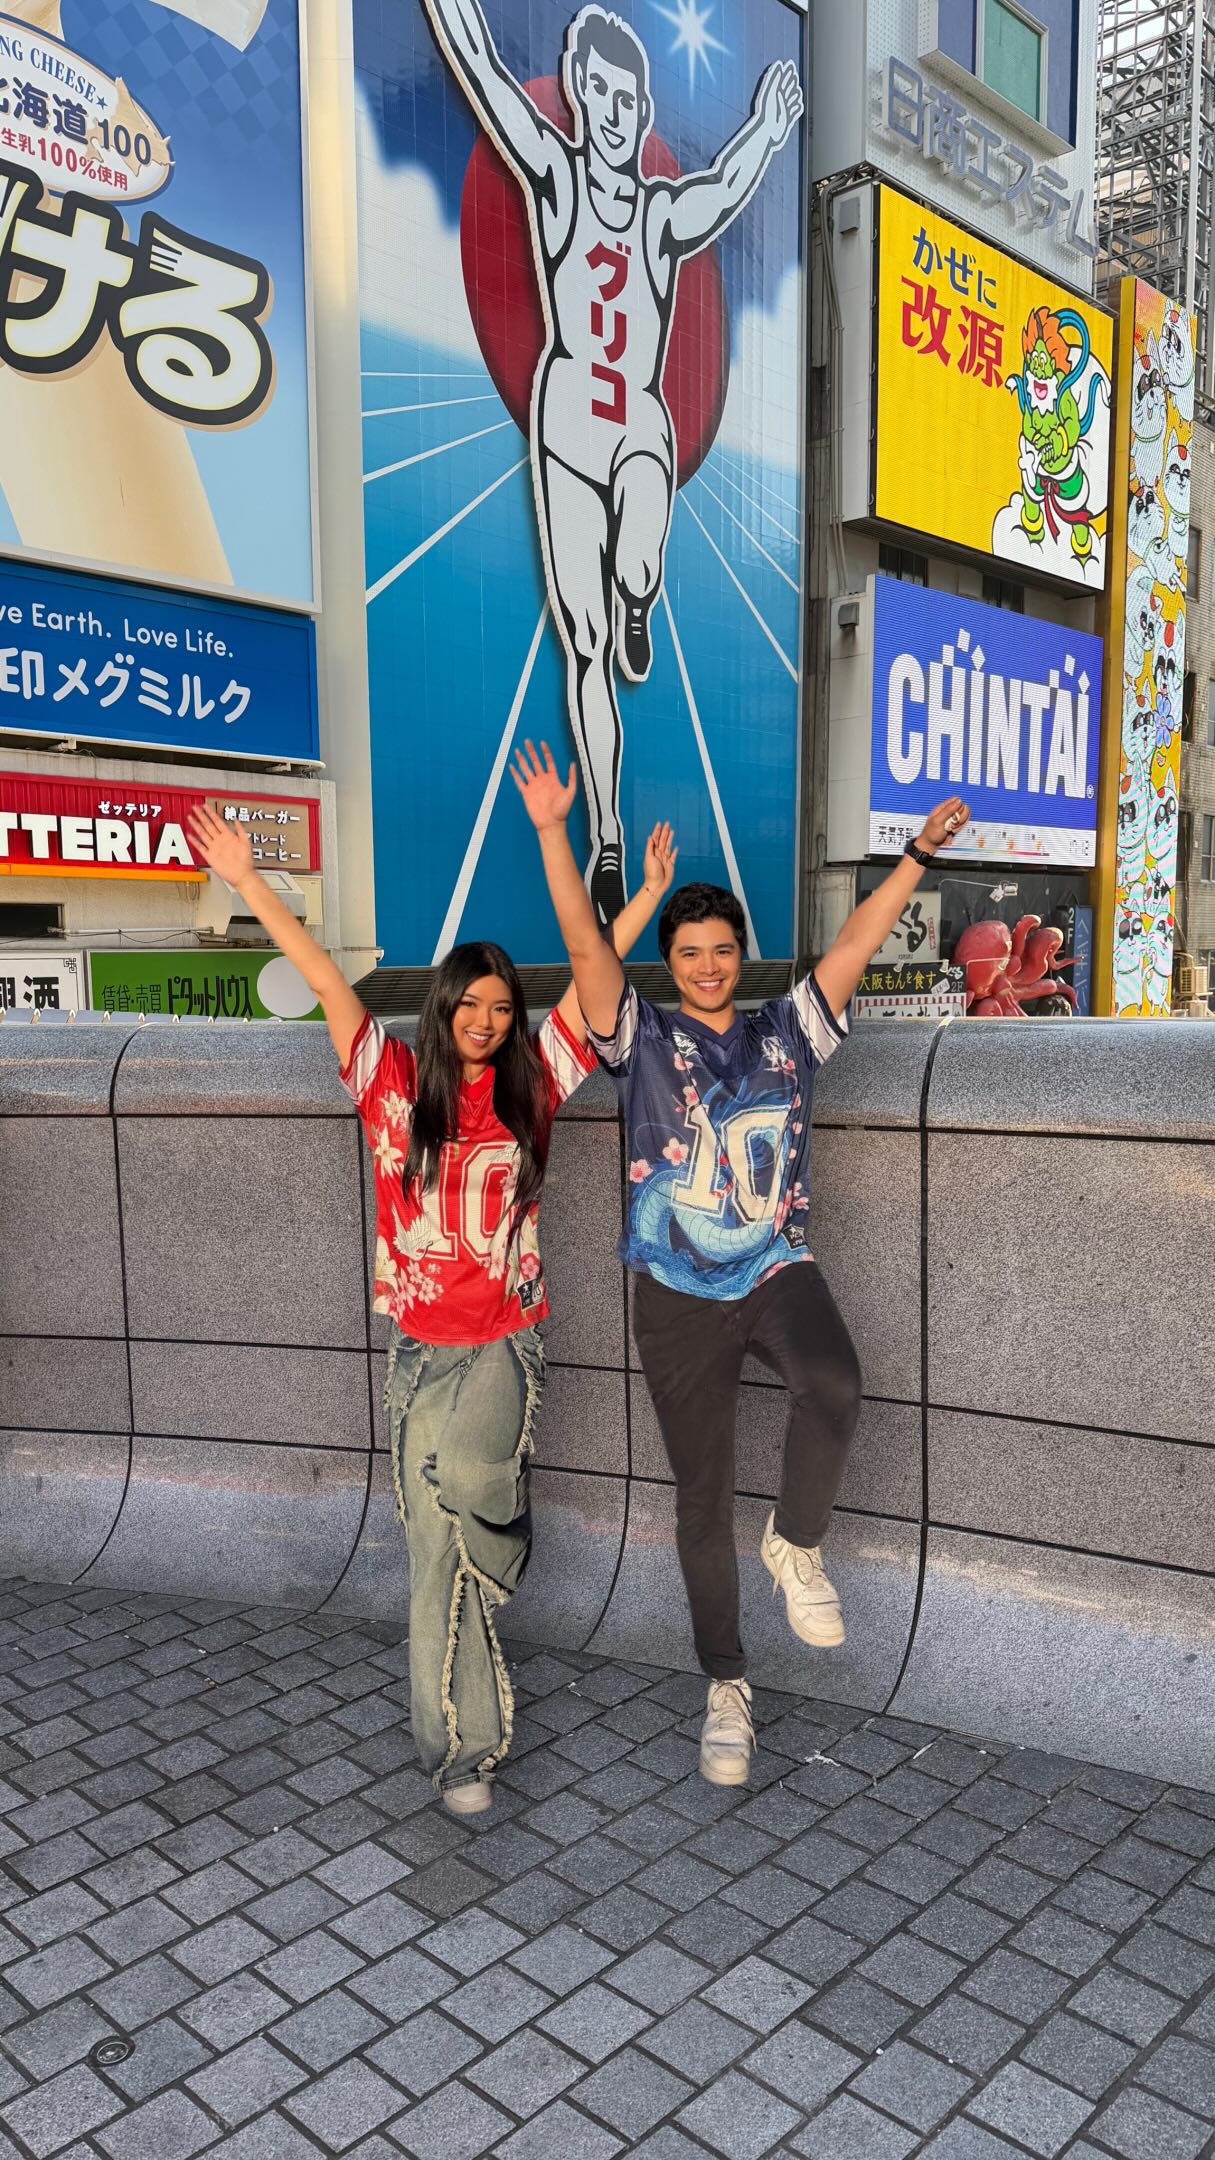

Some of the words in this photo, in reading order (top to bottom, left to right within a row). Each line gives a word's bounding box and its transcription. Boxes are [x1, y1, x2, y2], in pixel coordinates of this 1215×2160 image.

[30, 47, 96, 103] CHEESE
[1, 127, 128, 192] 生乳100%使用
[912, 226, 998, 310] かぜに
[585, 240, 632, 426] グリコ
[901, 275, 1005, 389] 改源
[32, 603, 111, 638] Earth.
[124, 618, 178, 649] Love
[186, 629, 234, 658] Life.
[887, 628, 1090, 799] CHINTAI
[98, 800, 162, 818] ゼッテリア
[224, 805, 301, 825] 絶品バーガー
[246, 832, 287, 846] トレード
[252, 847, 302, 861] コーヒー
[670, 1102, 794, 1225] 10
